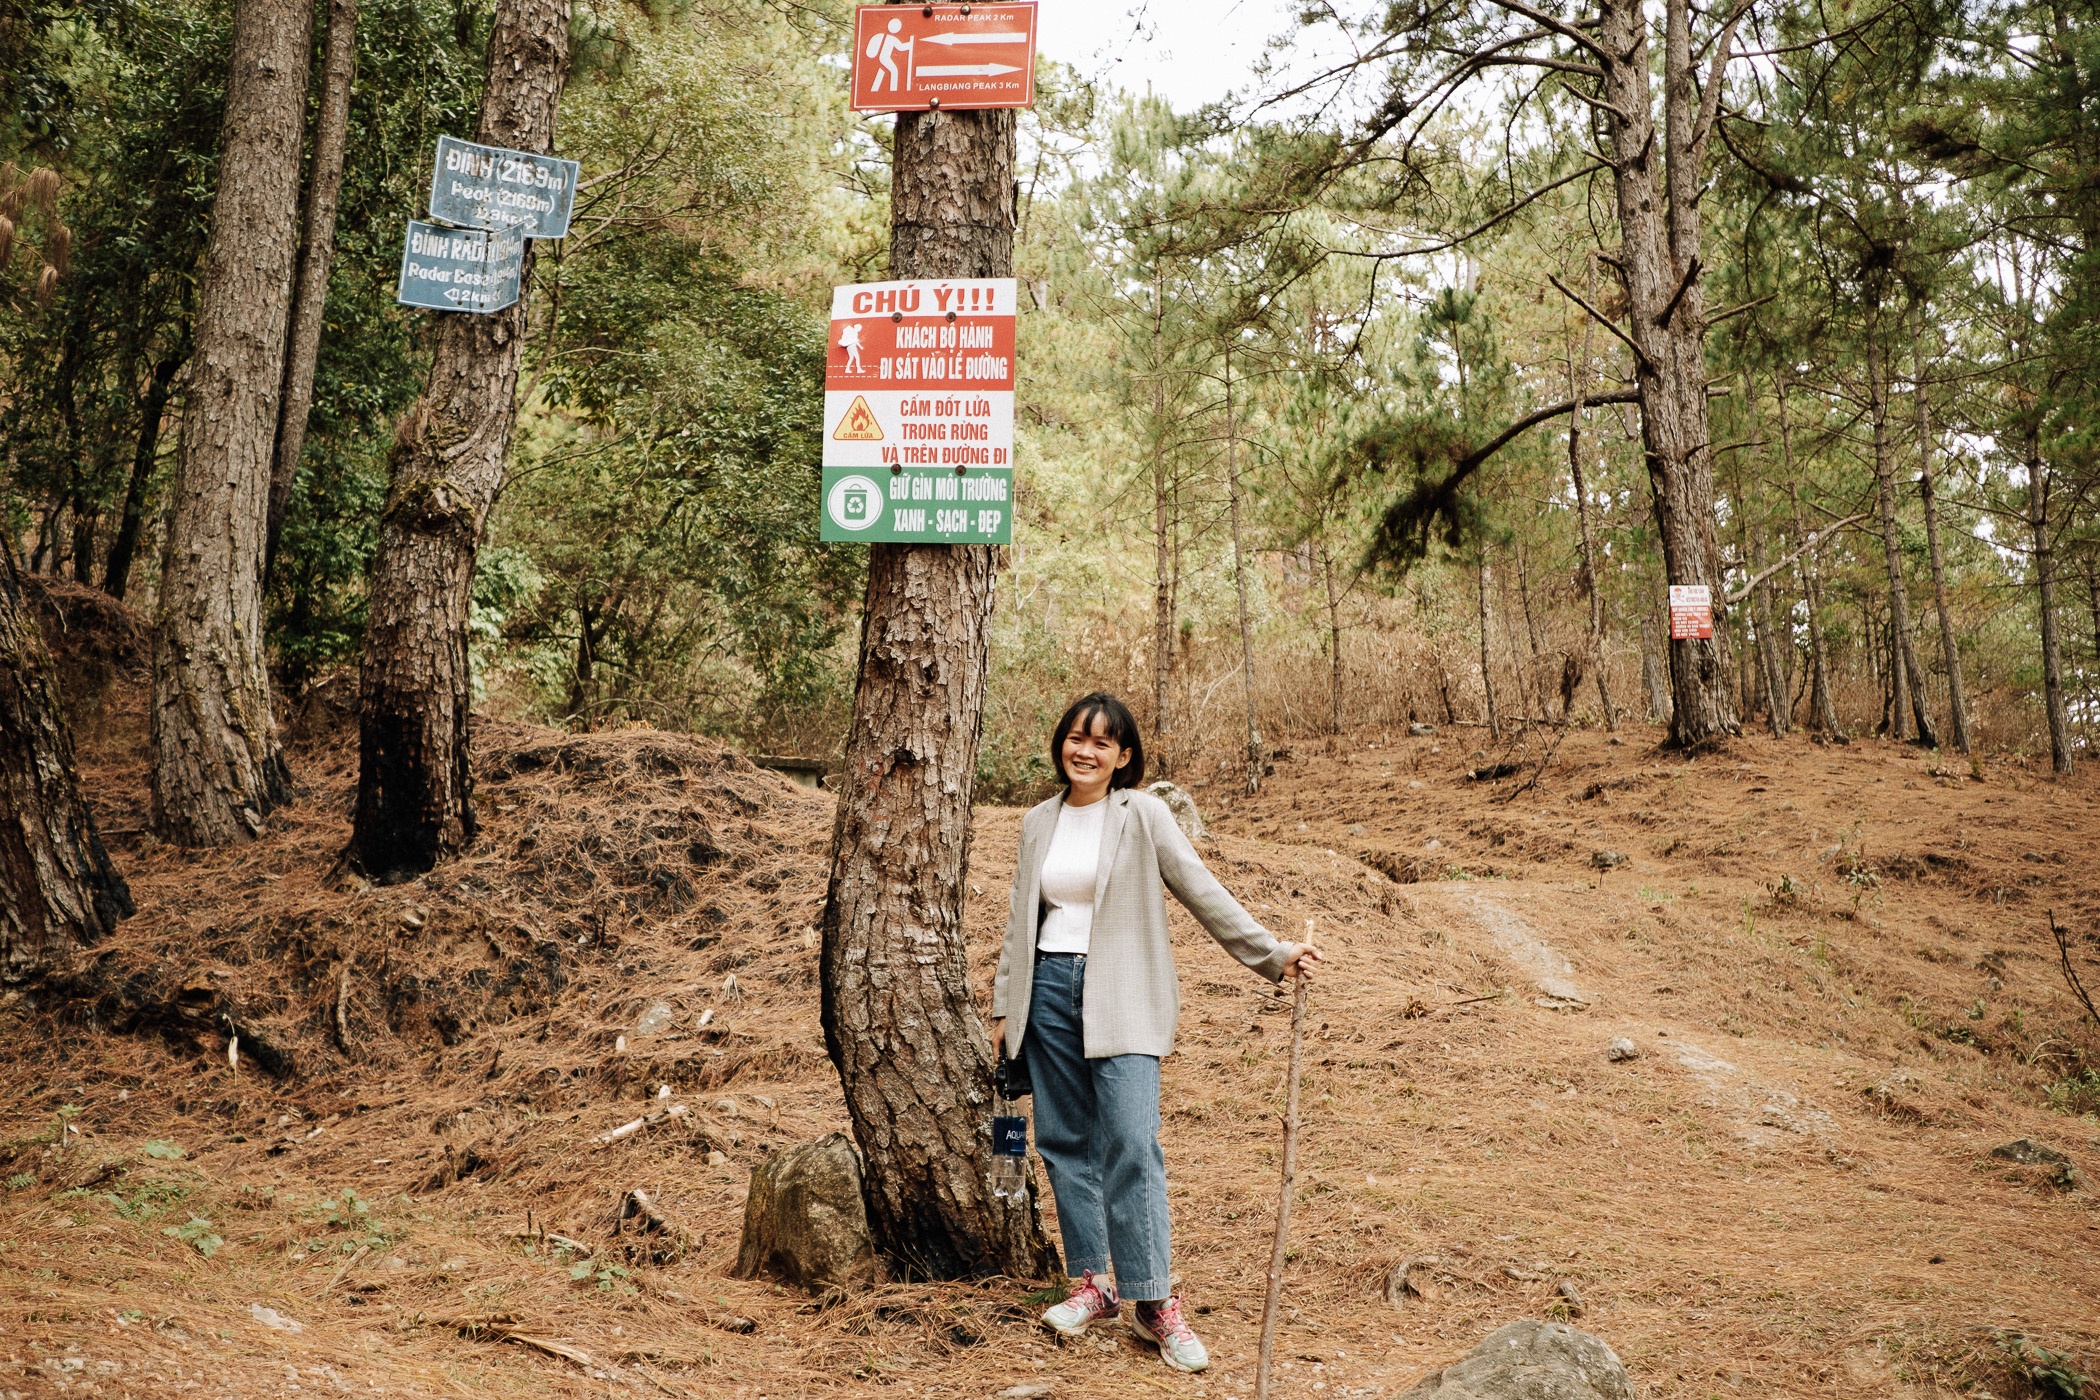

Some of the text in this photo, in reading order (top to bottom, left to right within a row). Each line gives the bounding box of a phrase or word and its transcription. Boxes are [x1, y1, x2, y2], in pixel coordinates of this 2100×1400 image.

[934, 14, 966, 22] RADAR
[919, 82, 970, 91] LANGBIANG
[972, 82, 996, 90] PEAK
[451, 181, 493, 203] Peak
[408, 262, 453, 282] Radar
[462, 290, 490, 303] 2km
[852, 283, 995, 314] CHÚ Ý!!!
[896, 322, 993, 354] KHÁCH BỘ HÀNH
[880, 350, 1008, 380] ĐI SÁT VÀO LỀ ĐƯỜNG
[900, 394, 991, 417] CẤM ĐỐT LỬA
[902, 420, 988, 440] TRONG RỪNG
[882, 443, 1007, 464] VÀ TRÊN ĐƯỜNG ĐI
[889, 472, 1007, 502] GIỮ GÌN MÔI TRƯỜNG
[893, 509, 925, 532] XANH
[936, 509, 968, 538] SẠCH
[978, 510, 1001, 538] ĐẸP
